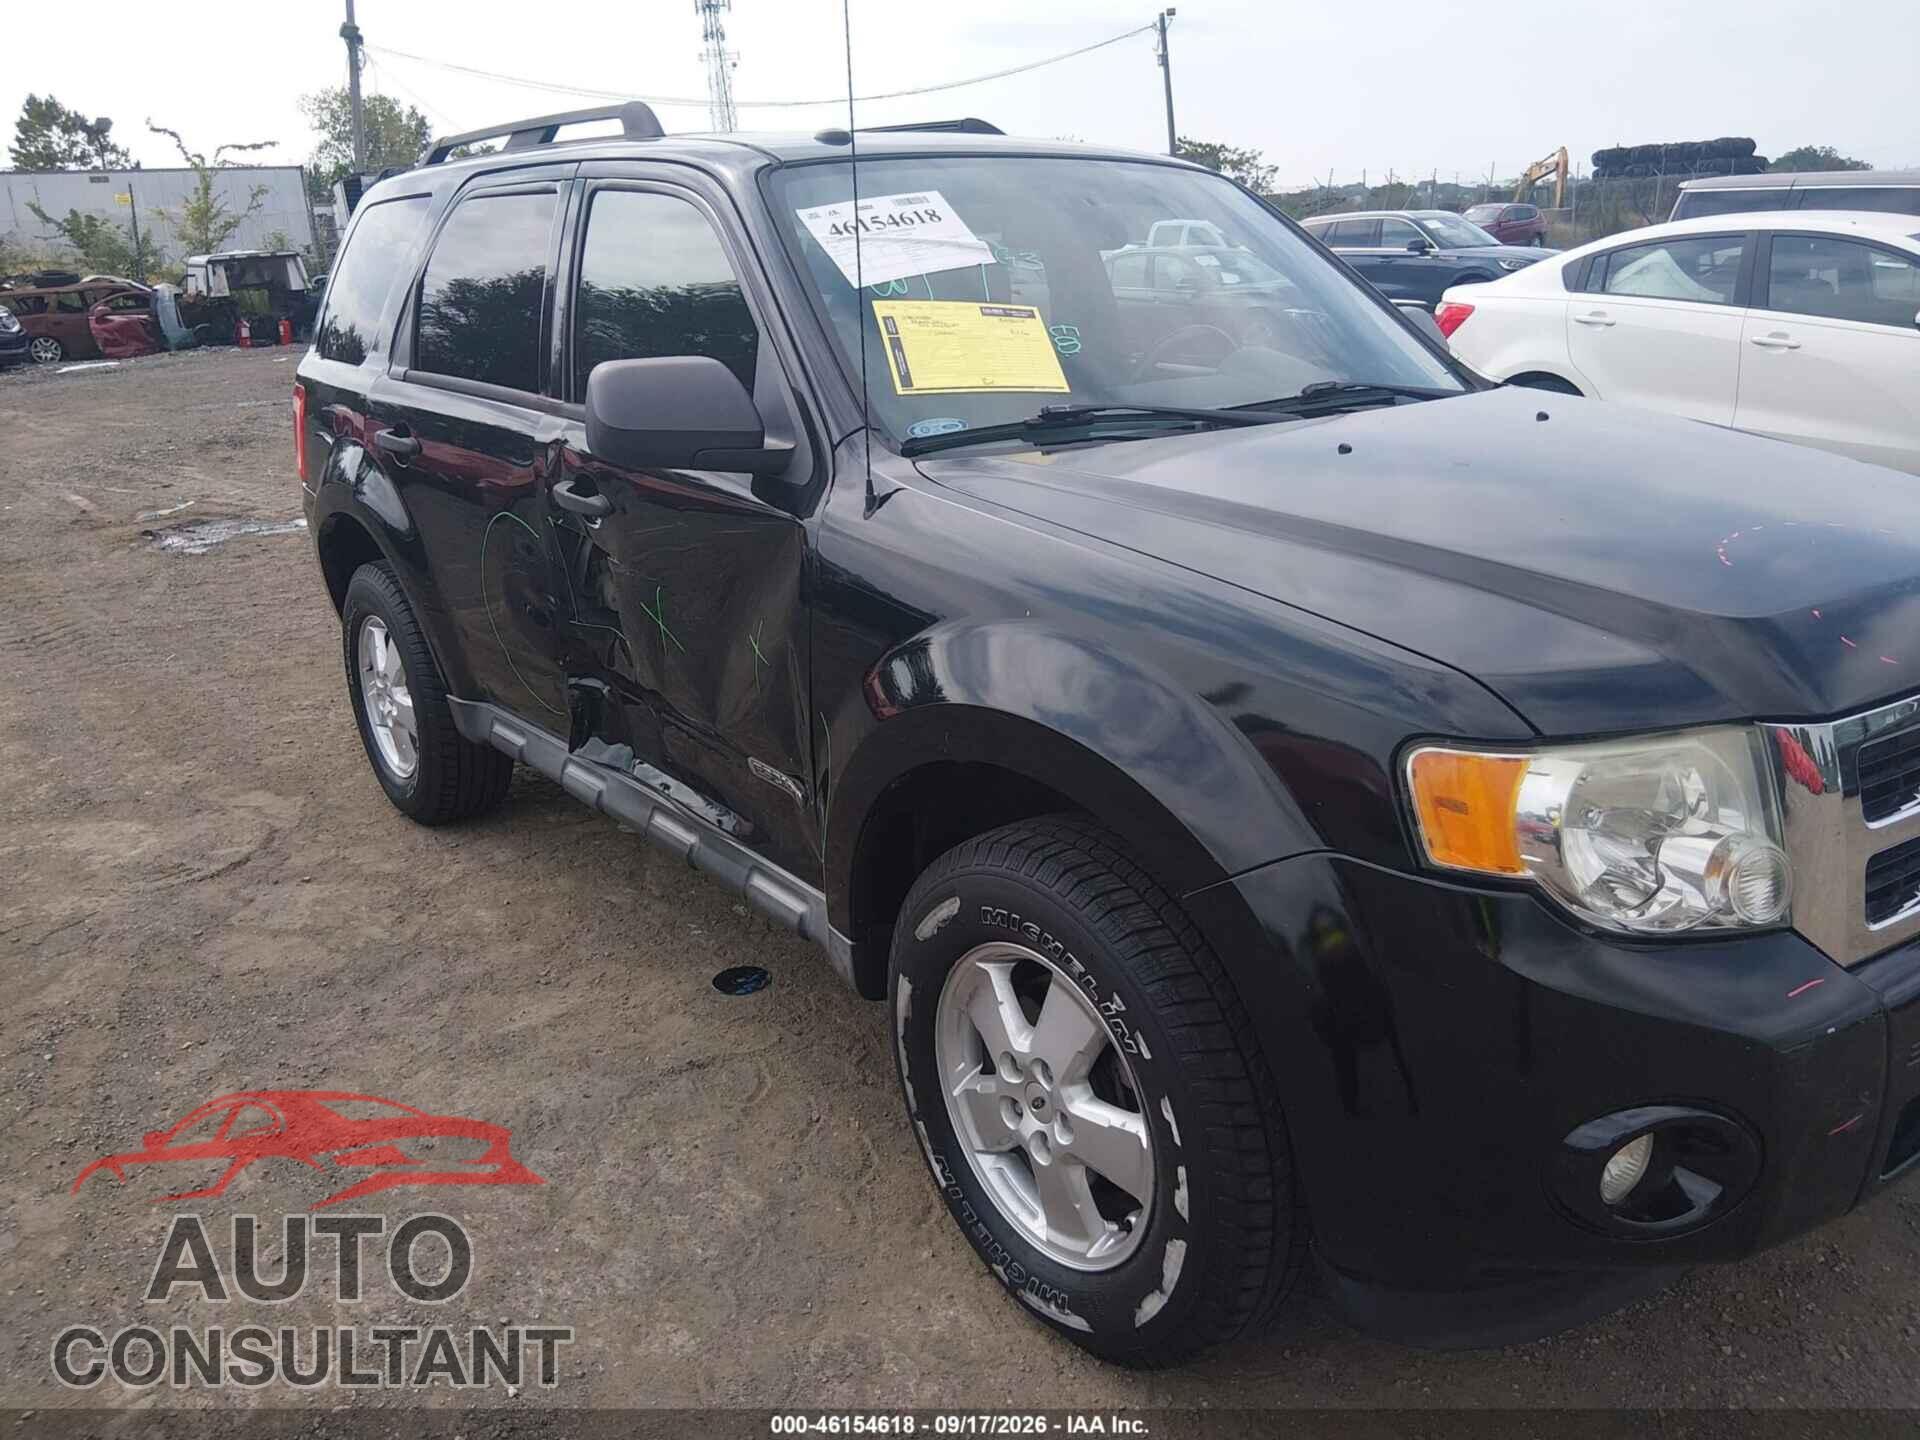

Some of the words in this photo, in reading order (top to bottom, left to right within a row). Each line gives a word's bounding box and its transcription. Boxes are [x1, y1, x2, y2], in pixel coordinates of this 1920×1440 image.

[828, 207, 943, 237] 46154618
[979, 906, 1142, 1056] MICHELIN
[934, 1154, 1073, 1317] MICHELIN
